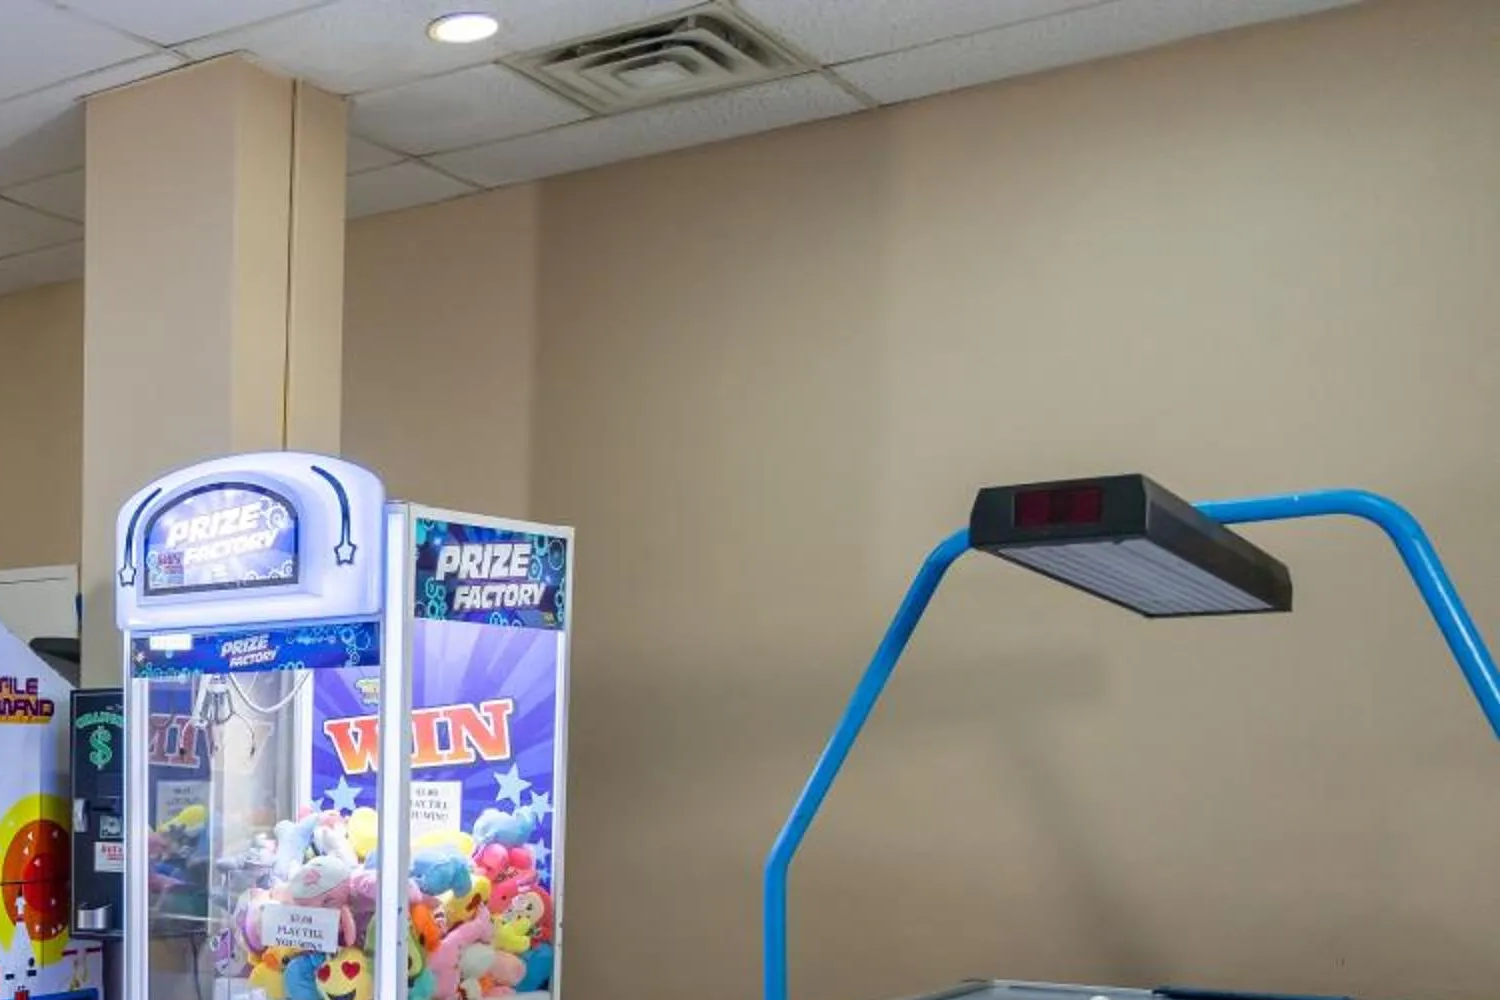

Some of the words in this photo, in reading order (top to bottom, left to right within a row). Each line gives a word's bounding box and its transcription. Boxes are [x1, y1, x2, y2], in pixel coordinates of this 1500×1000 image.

[164, 502, 262, 549] PRIZE
[183, 527, 280, 565] FACTORY
[436, 543, 532, 581] PRIZE
[454, 583, 546, 611] FACTORY
[220, 634, 269, 657] PRIZE
[229, 645, 279, 668] FACTORY
[324, 699, 513, 774] WIN
